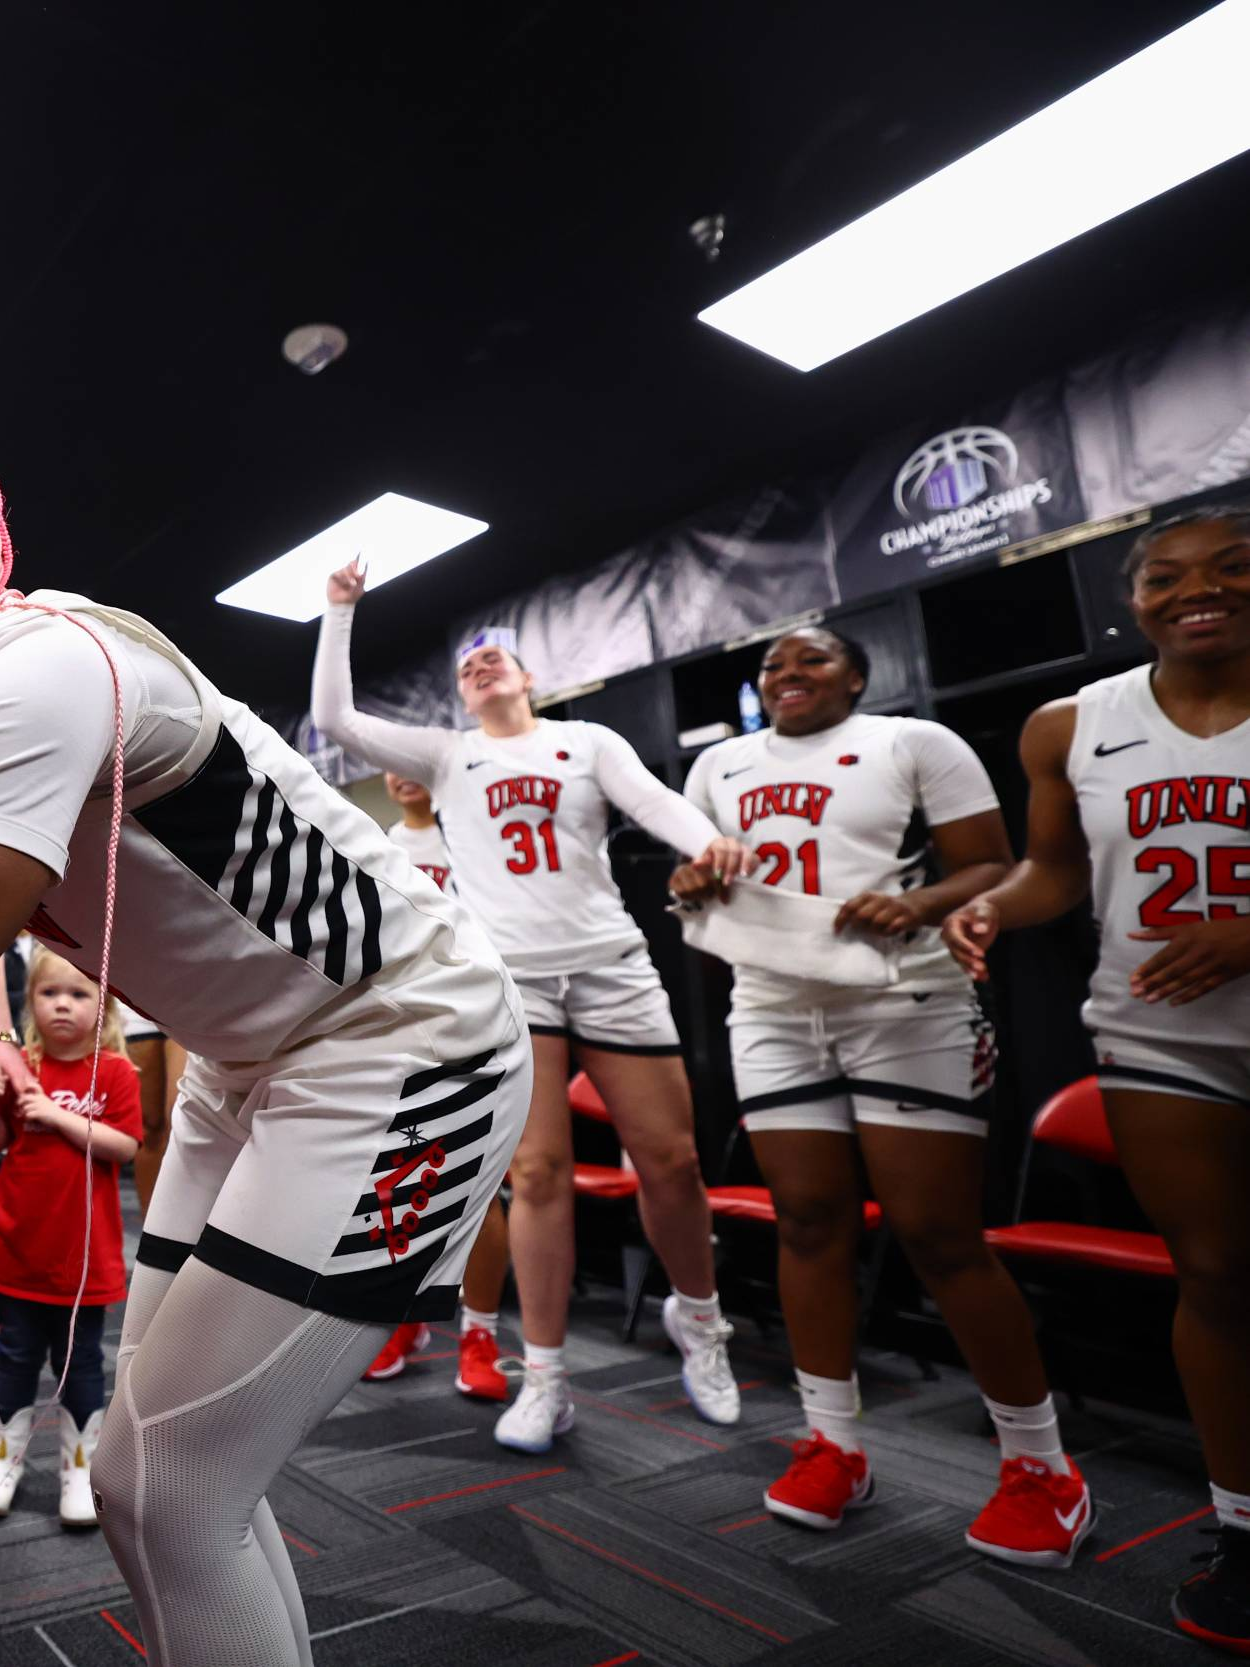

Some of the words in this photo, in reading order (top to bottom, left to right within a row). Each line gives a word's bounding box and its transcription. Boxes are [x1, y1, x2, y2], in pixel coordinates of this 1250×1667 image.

[879, 477, 1052, 556] CHAMPIONSHIPS
[485, 774, 563, 818] UNLV
[739, 782, 834, 832] UNLV
[1126, 776, 1250, 839] UNL
[501, 817, 562, 876] 31
[754, 838, 821, 896] 21
[1135, 846, 1250, 927] 25
